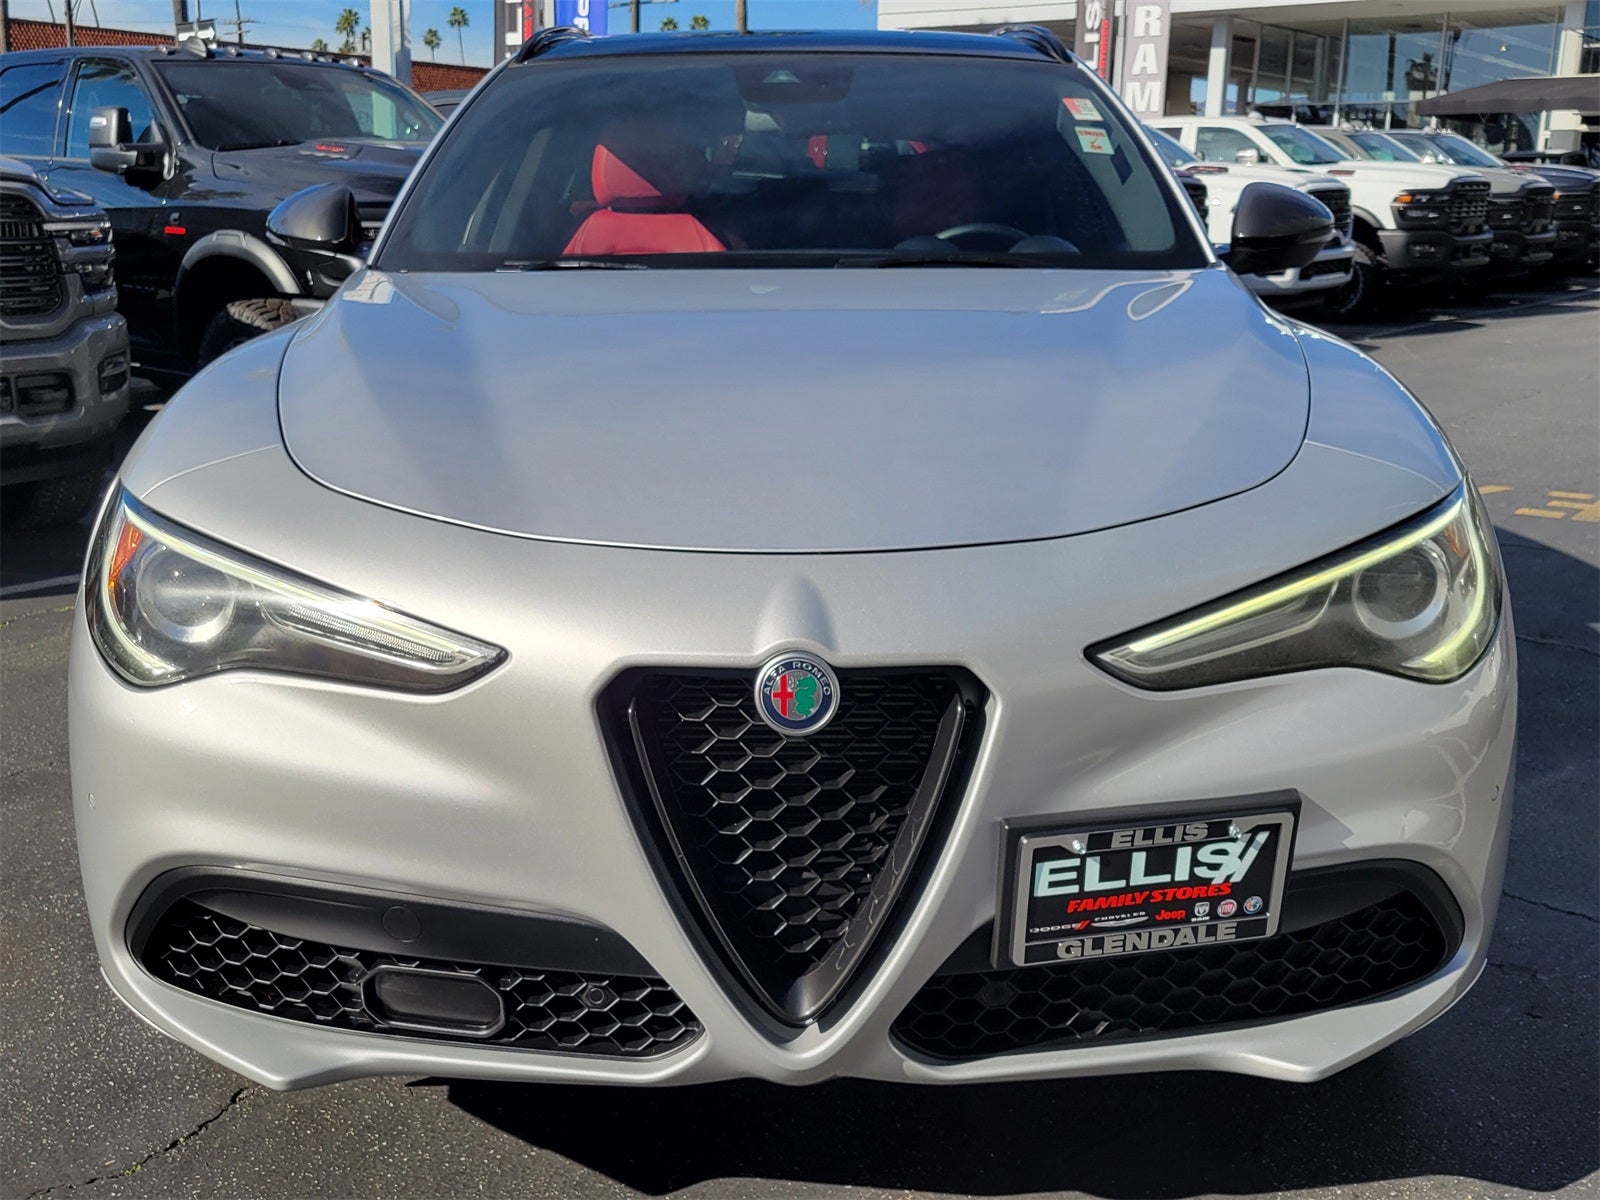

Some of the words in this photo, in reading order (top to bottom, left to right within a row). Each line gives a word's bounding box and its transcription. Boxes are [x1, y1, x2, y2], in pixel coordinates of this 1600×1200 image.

[1124, 5, 1162, 112] RAM
[764, 665, 786, 695] ALFA
[792, 661, 831, 695] ROMEO
[1111, 823, 1208, 848] ELLIS
[1034, 842, 1243, 897] ELLIS
[1067, 890, 1150, 913] FAMILY
[1150, 882, 1232, 903] STORES
[1029, 922, 1080, 933] DODGE
[1155, 910, 1186, 920] Jeep
[1057, 921, 1238, 958] GLENDALE
